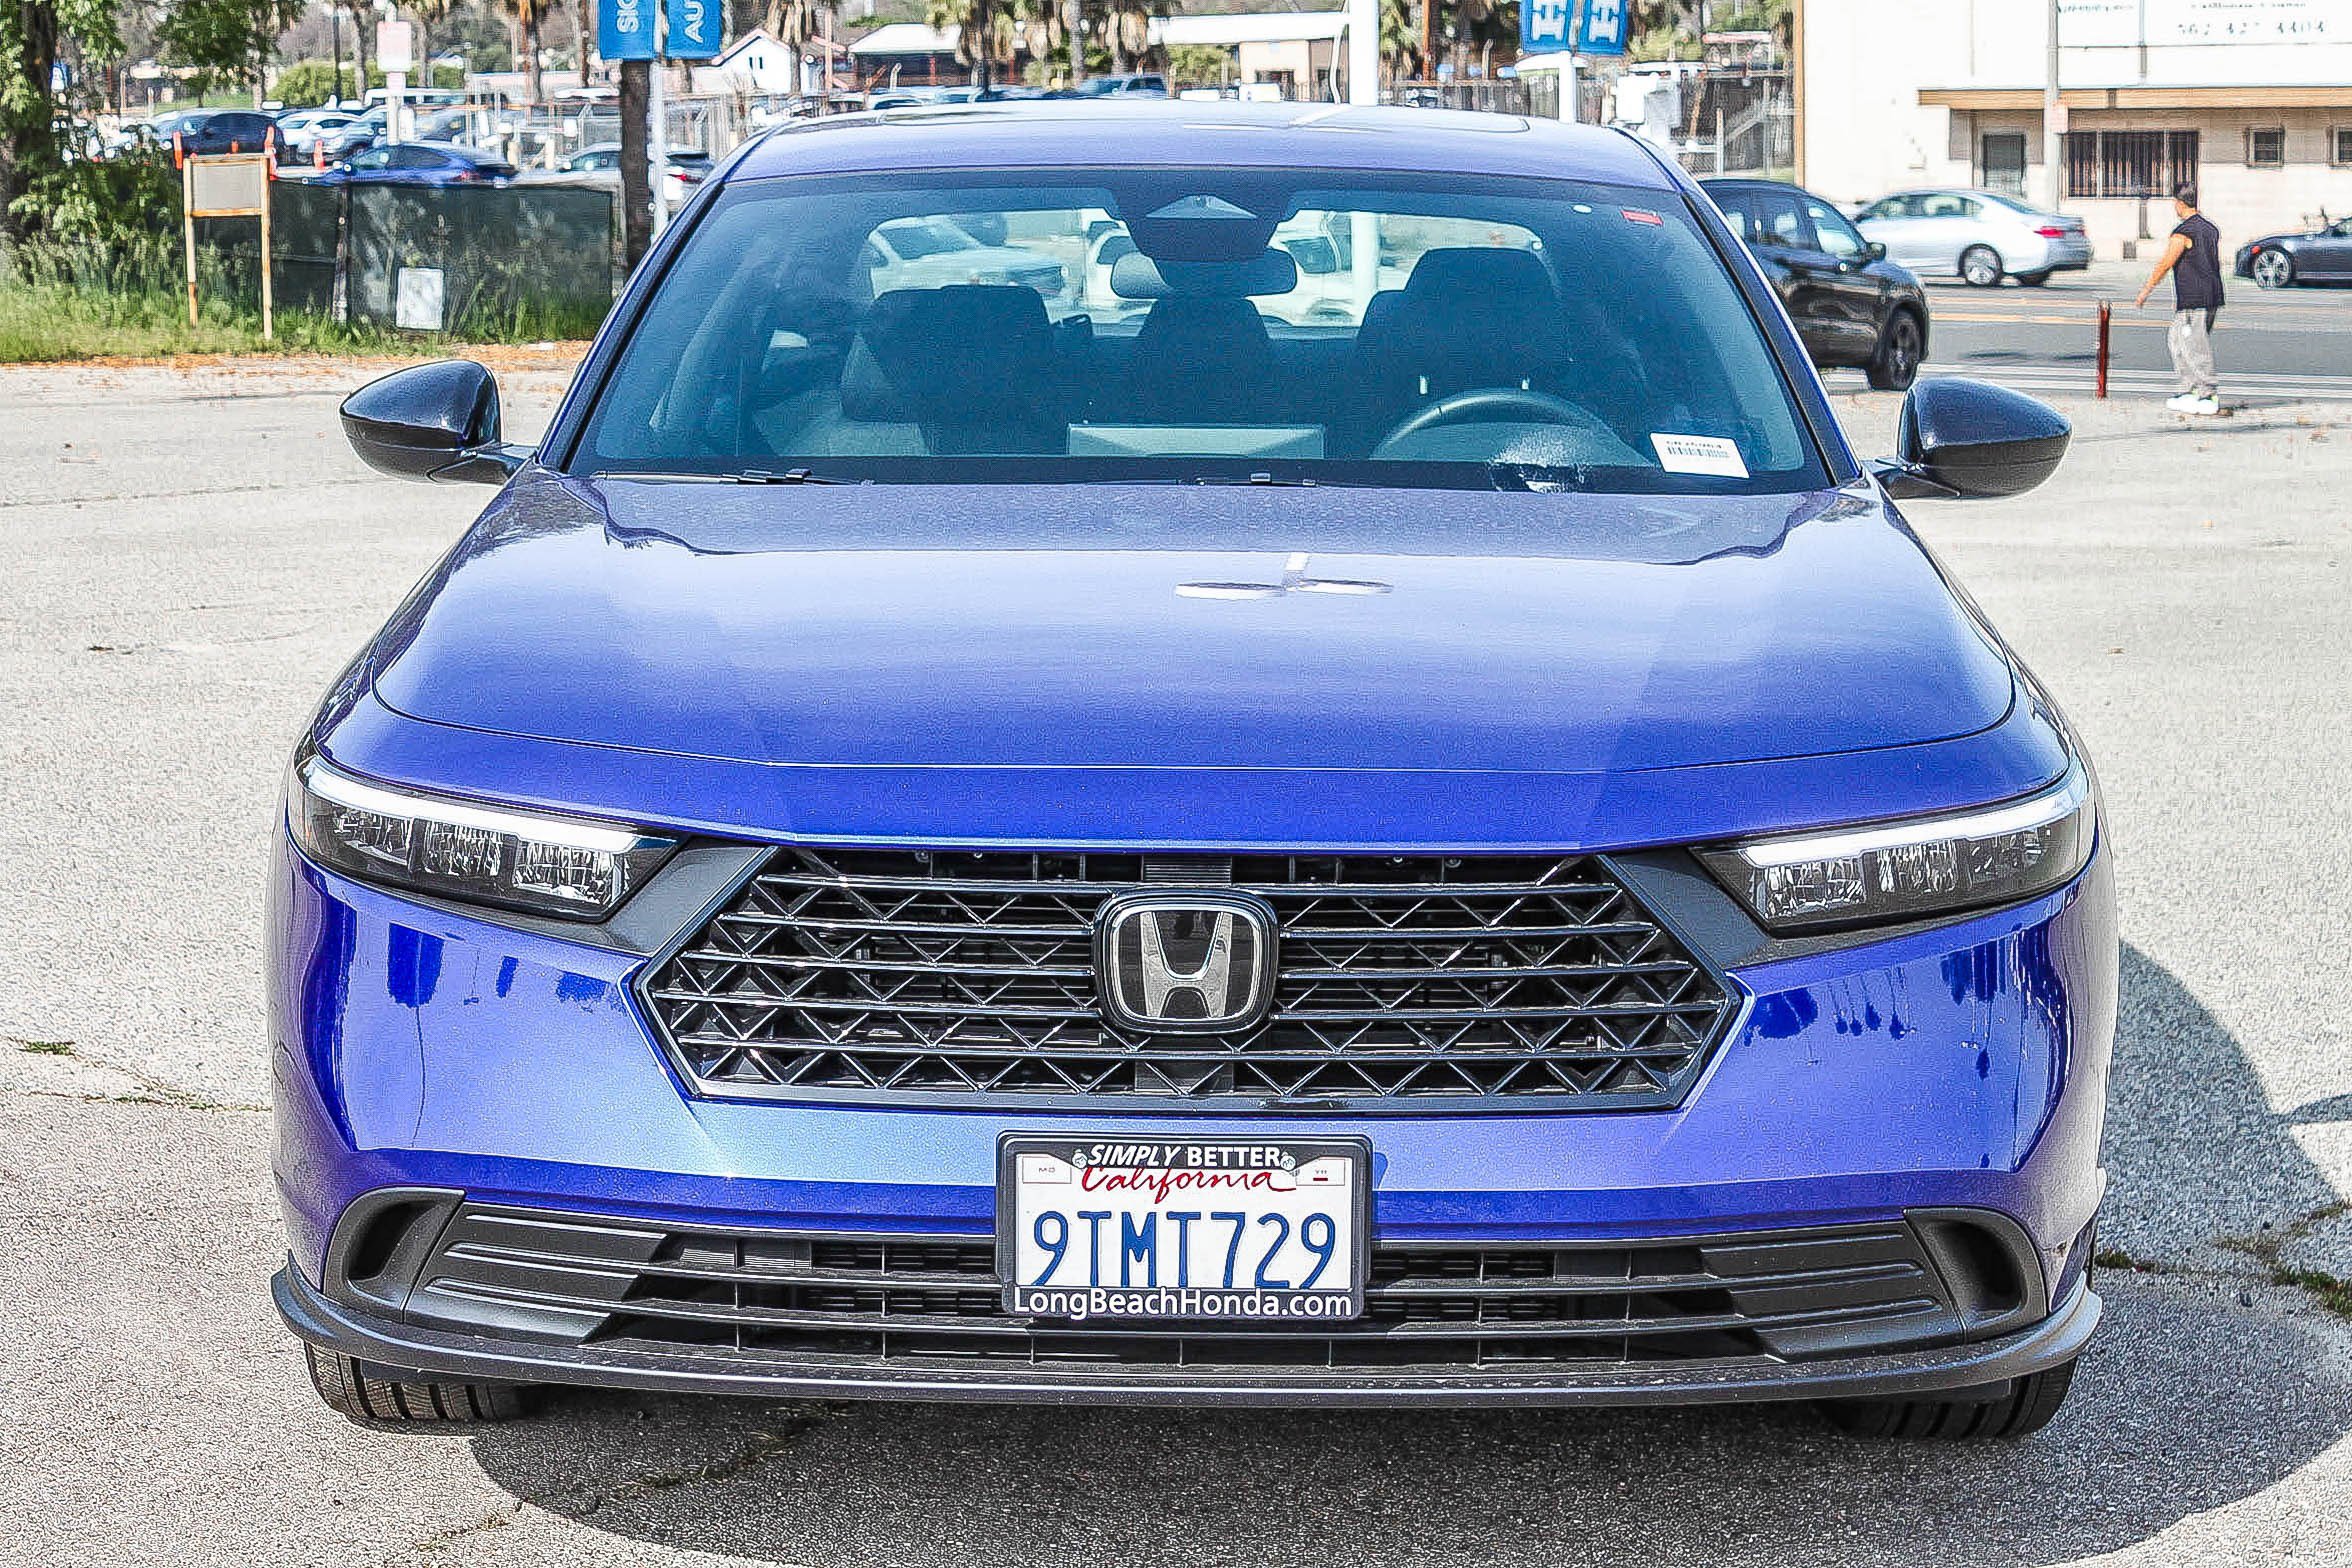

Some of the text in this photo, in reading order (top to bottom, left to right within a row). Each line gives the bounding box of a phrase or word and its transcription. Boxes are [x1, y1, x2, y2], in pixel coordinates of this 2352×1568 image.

[1087, 1144, 1281, 1168] SIMPLY BETTER
[1081, 1166, 1297, 1205] California
[1030, 1210, 1337, 1289] 9TMT729
[1014, 1287, 1353, 1320] LongBeachHonda.com
